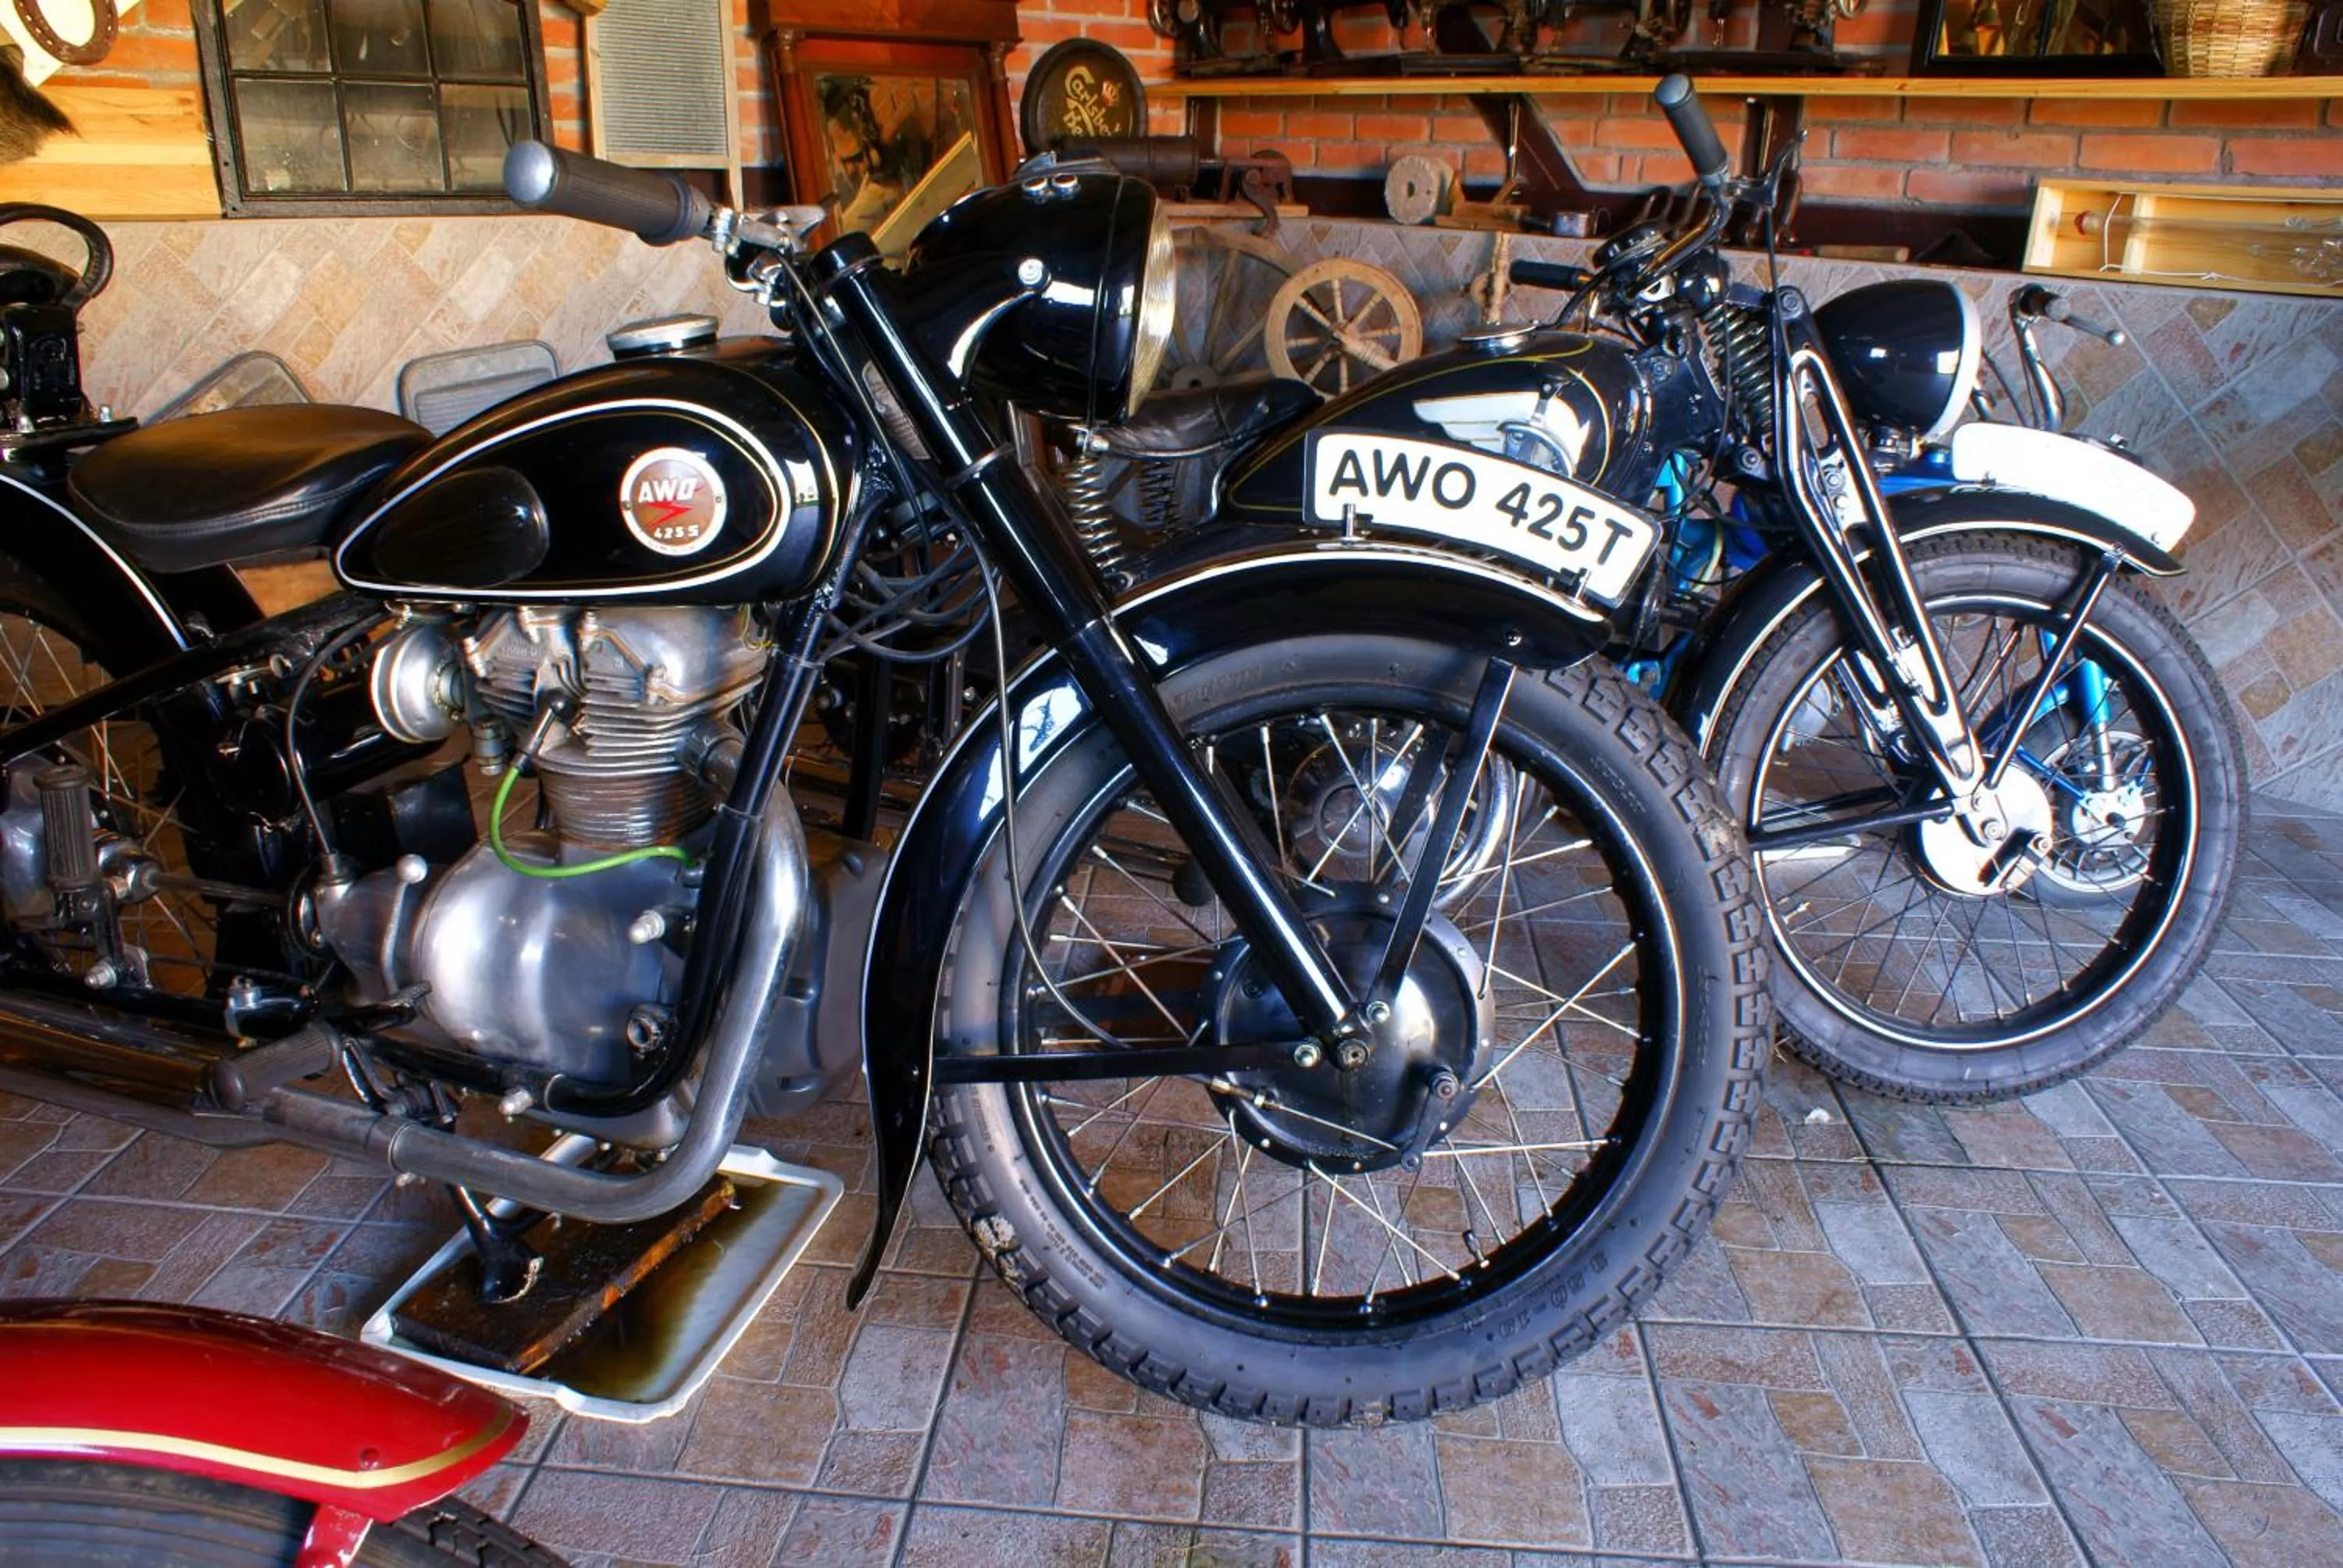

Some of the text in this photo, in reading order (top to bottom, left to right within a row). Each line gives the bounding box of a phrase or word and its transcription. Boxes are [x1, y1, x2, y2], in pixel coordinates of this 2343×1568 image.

[1065, 66, 1122, 137] Carlsbe
[639, 478, 697, 502] AWO
[1328, 448, 1634, 566] AWO 425T
